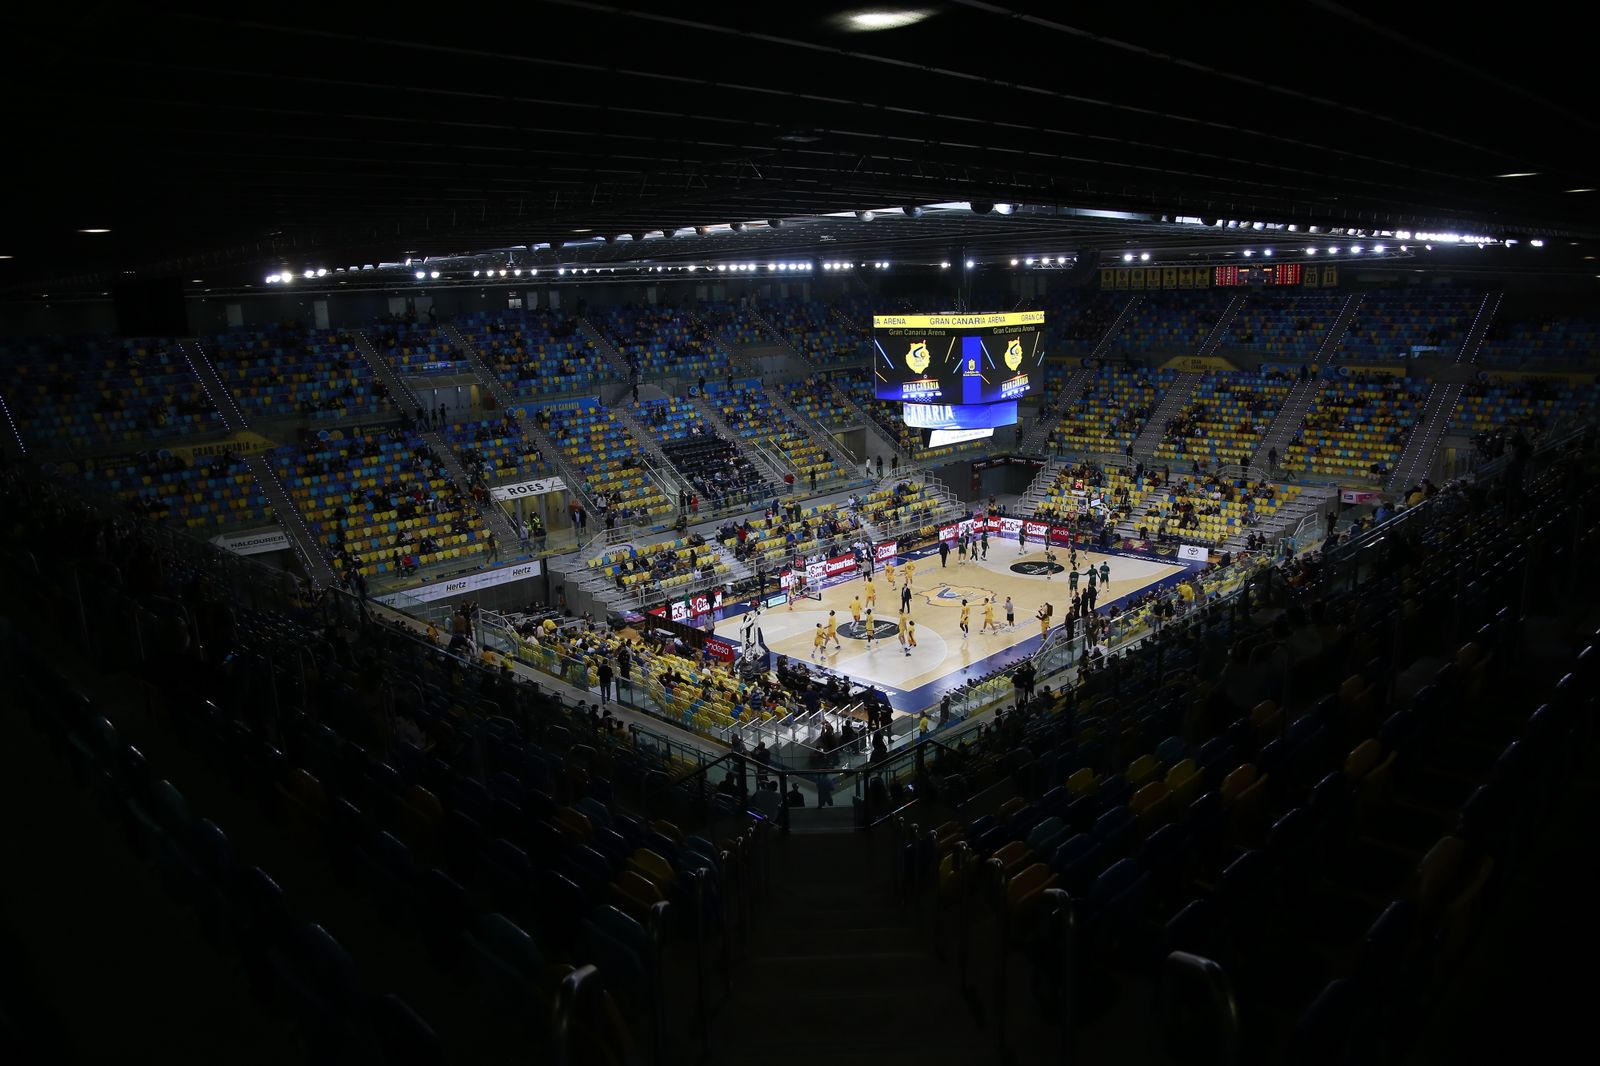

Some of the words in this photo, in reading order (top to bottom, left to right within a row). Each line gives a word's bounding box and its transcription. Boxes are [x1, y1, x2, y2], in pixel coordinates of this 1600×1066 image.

[951, 316, 986, 325] CANARIA
[988, 316, 1006, 324] ARENA
[1021, 314, 1035, 322] GRAN
[888, 328, 903, 336] Gran
[904, 328, 927, 336] Canaria
[928, 328, 946, 336] Arena
[993, 327, 1004, 335] Gran
[1004, 326, 1021, 334] Canaria
[917, 381, 940, 392] CANARIA
[904, 404, 954, 424] CANARIA
[507, 483, 544, 496] ROES
[230, 535, 285, 549] HALCOURIER
[511, 566, 532, 577] Hertz
[445, 581, 467, 592] Hertz
